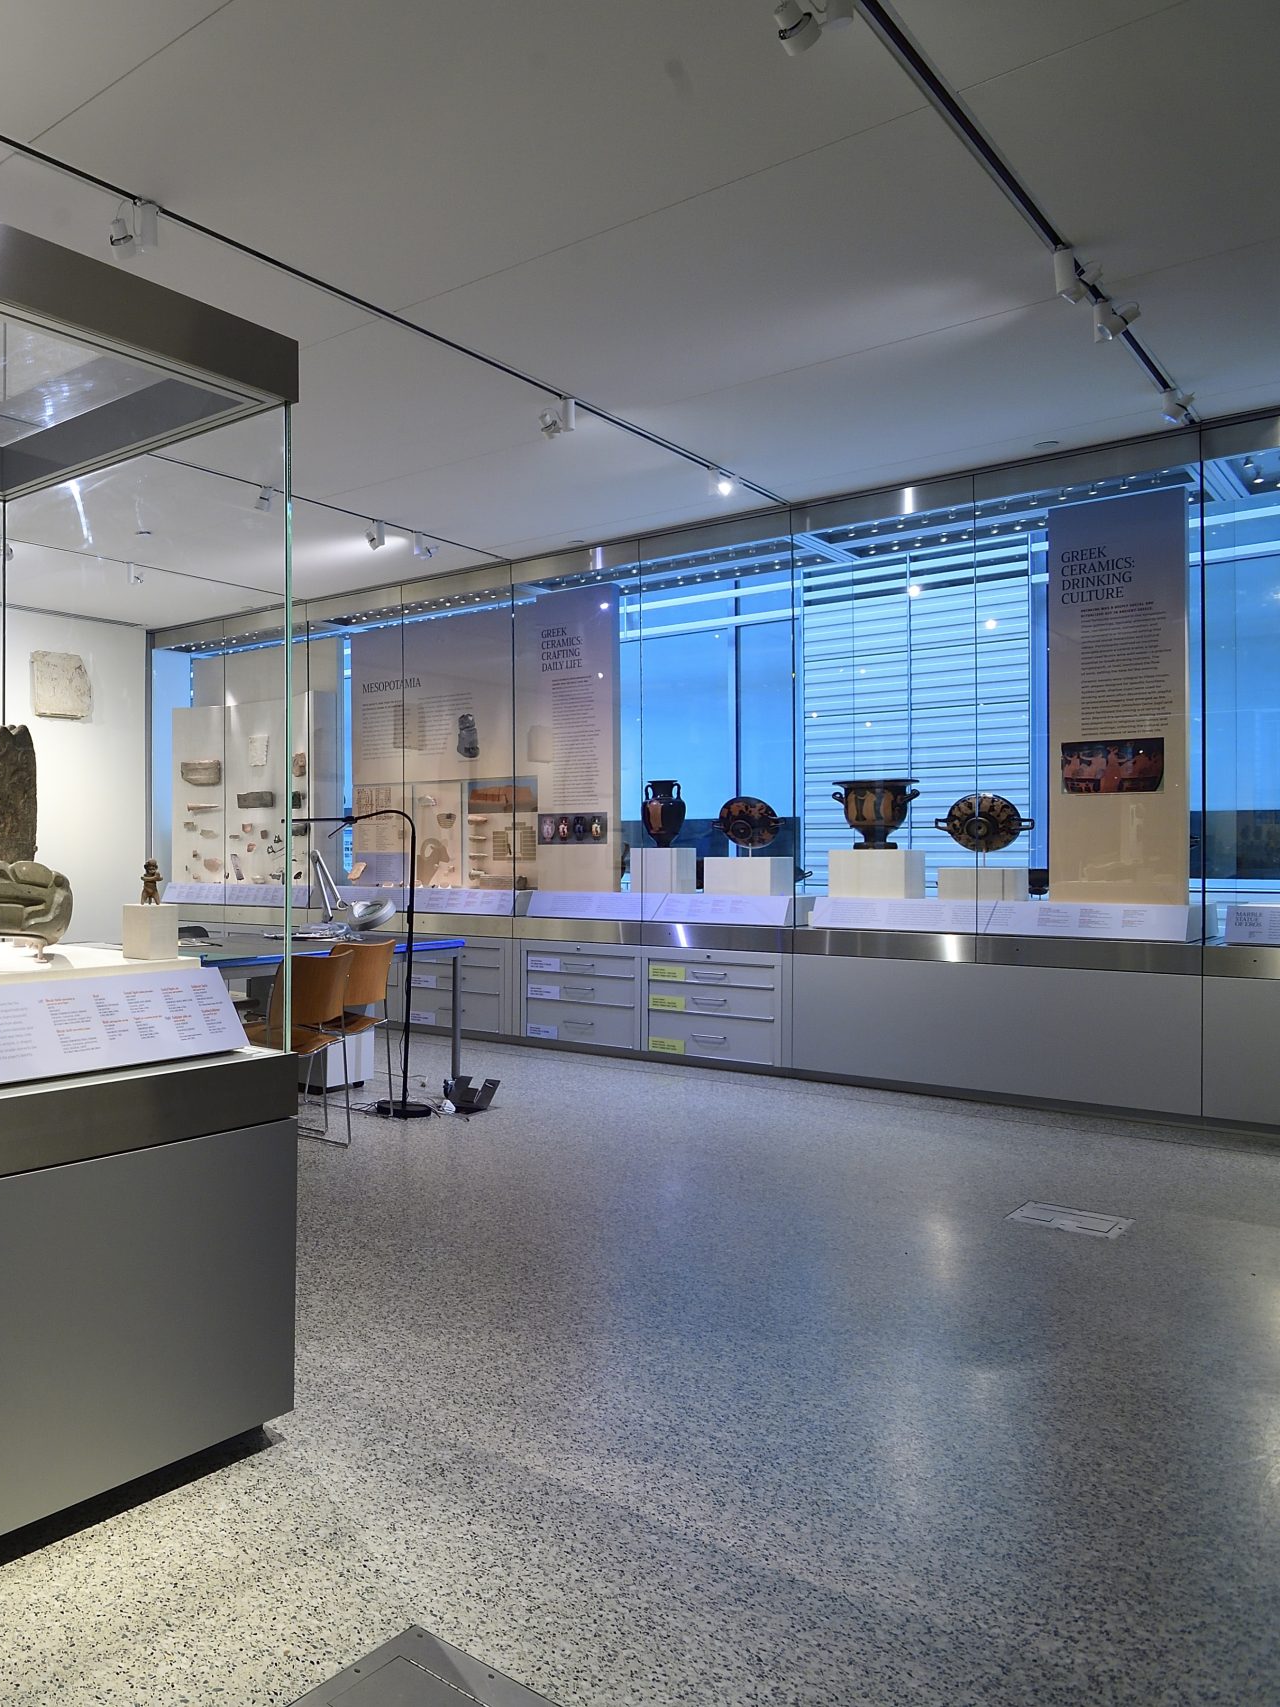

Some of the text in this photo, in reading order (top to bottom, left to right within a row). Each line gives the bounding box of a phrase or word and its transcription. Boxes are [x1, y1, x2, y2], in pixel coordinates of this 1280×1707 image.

[1061, 546, 1107, 563] GREEK
[1061, 557, 1135, 576] CERAMICS:
[1062, 571, 1132, 590] DRINKING
[1061, 586, 1124, 605] CULTURE
[541, 627, 567, 639] GREEK
[541, 637, 583, 650] CERAMICS:
[541, 648, 581, 661] CRAFTING
[541, 659, 582, 672] DAILY LIFE
[362, 677, 421, 694] MESOPOTAMIA
